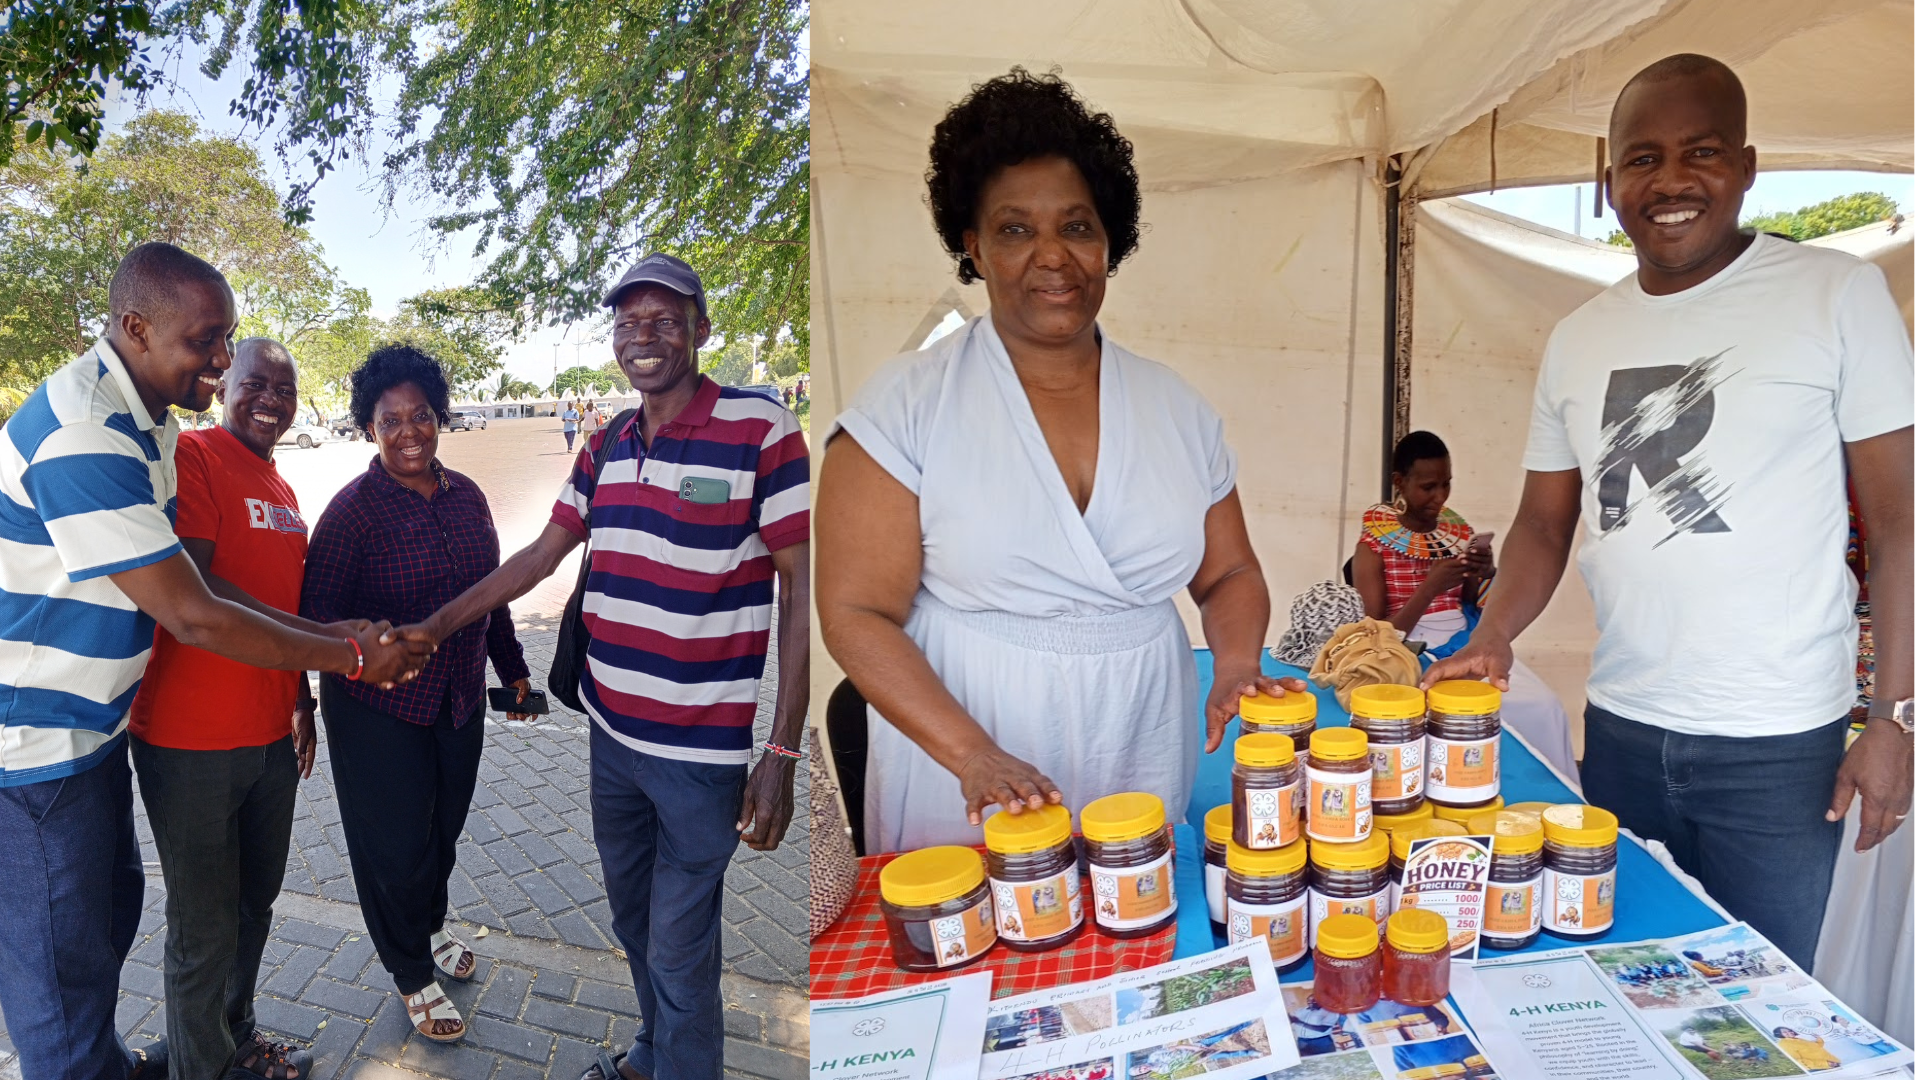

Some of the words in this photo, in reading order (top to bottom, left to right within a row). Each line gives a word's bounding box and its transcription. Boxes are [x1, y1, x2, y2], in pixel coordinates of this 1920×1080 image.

[1594, 355, 1738, 540] R
[1407, 862, 1486, 884] HONEY
[1420, 882, 1446, 891] PRICE
[1448, 881, 1467, 890] LIST
[1509, 1005, 1542, 1017] 4-H
[1544, 1000, 1608, 1013] KENYA
[999, 1042, 1066, 1073] 4-H
[1085, 1017, 1196, 1053] POLLINATORS
[843, 1047, 915, 1067] KENYA
[862, 1069, 899, 1078] Network
